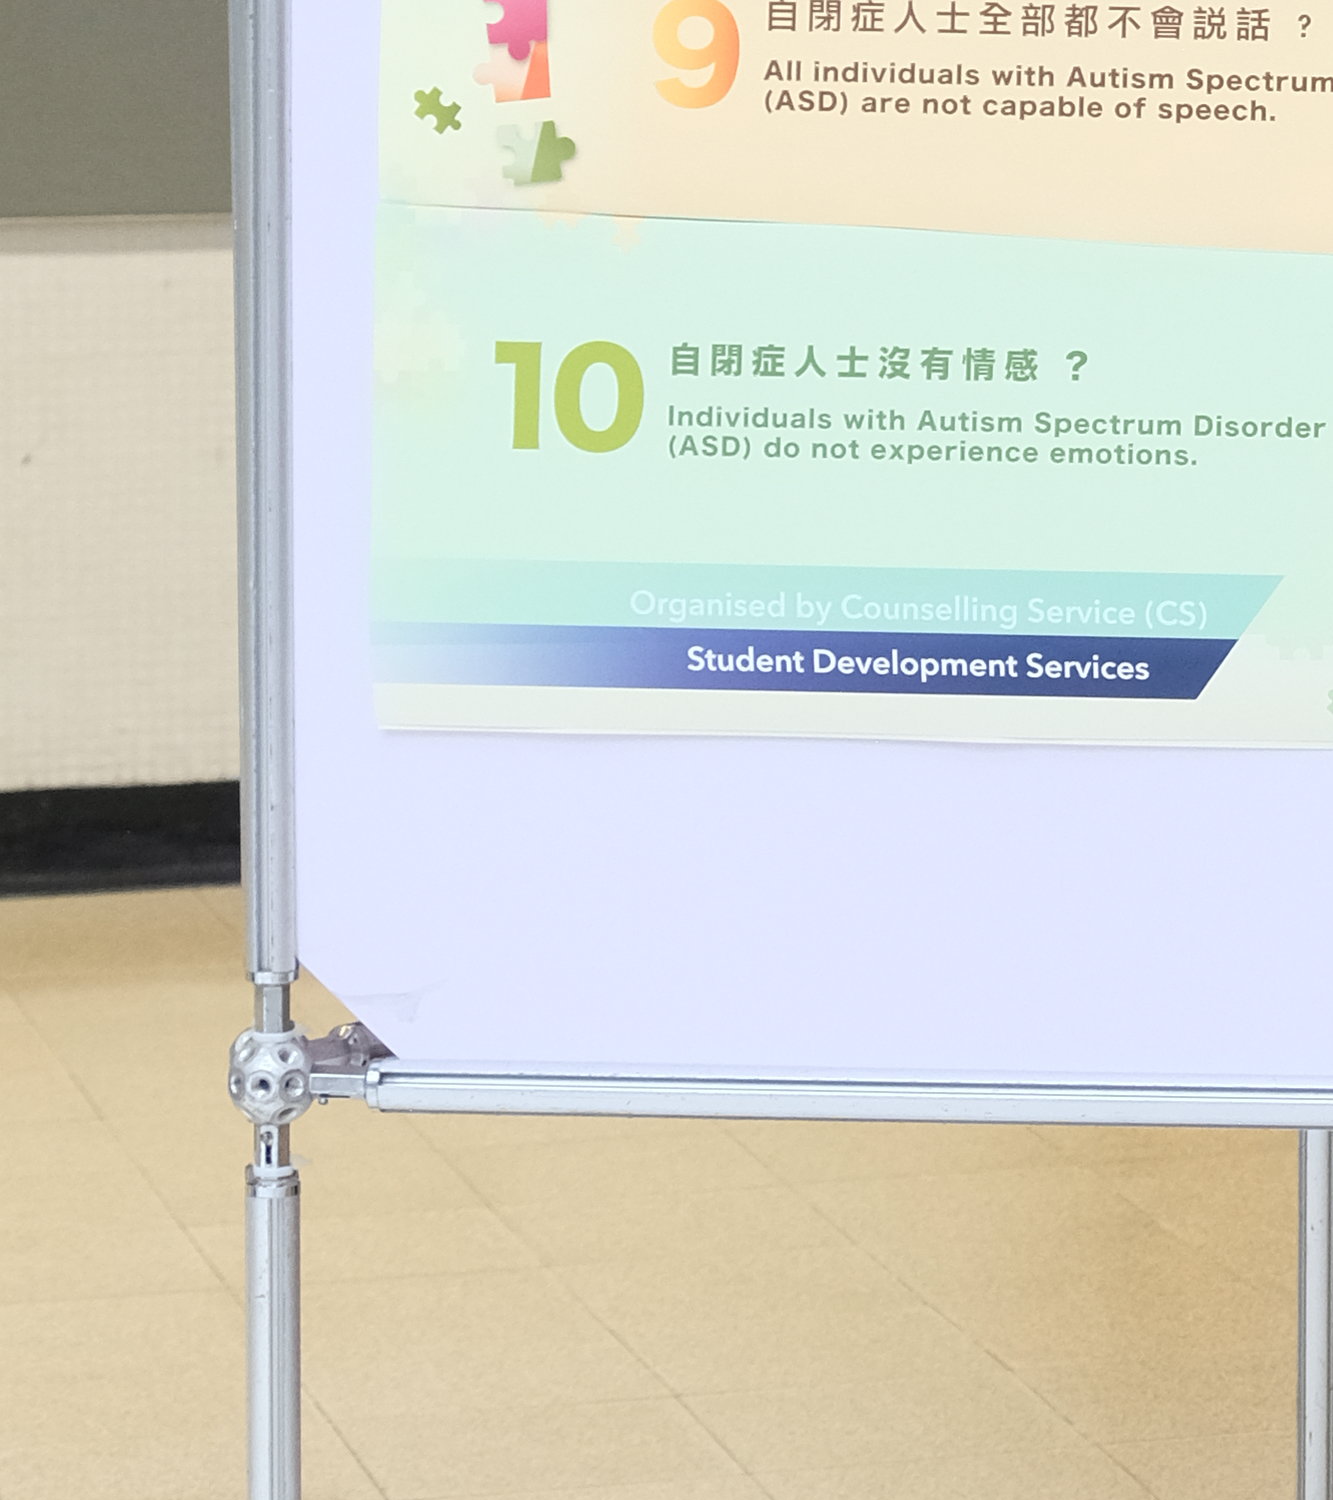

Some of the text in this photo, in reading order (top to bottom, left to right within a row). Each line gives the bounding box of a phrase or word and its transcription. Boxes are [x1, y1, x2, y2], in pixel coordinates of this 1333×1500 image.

[763, 59, 802, 82] All
[813, 60, 980, 86] individuals
[991, 64, 1055, 87] with
[1066, 66, 1174, 90] Autism
[764, 89, 1276, 124] (ASD) are not capable of speech.
[671, 341, 1088, 382] 自閉症人士沒有情感？
[495, 340, 644, 453] 10
[668, 404, 1327, 439] Individuals with Autism Spectrum Disorder
[668, 434, 1197, 466] (ASD) do not experience emotions.
[630, 590, 1207, 630] Organised by Counselling Service (CS)
[686, 647, 1149, 682] Student Development Services
